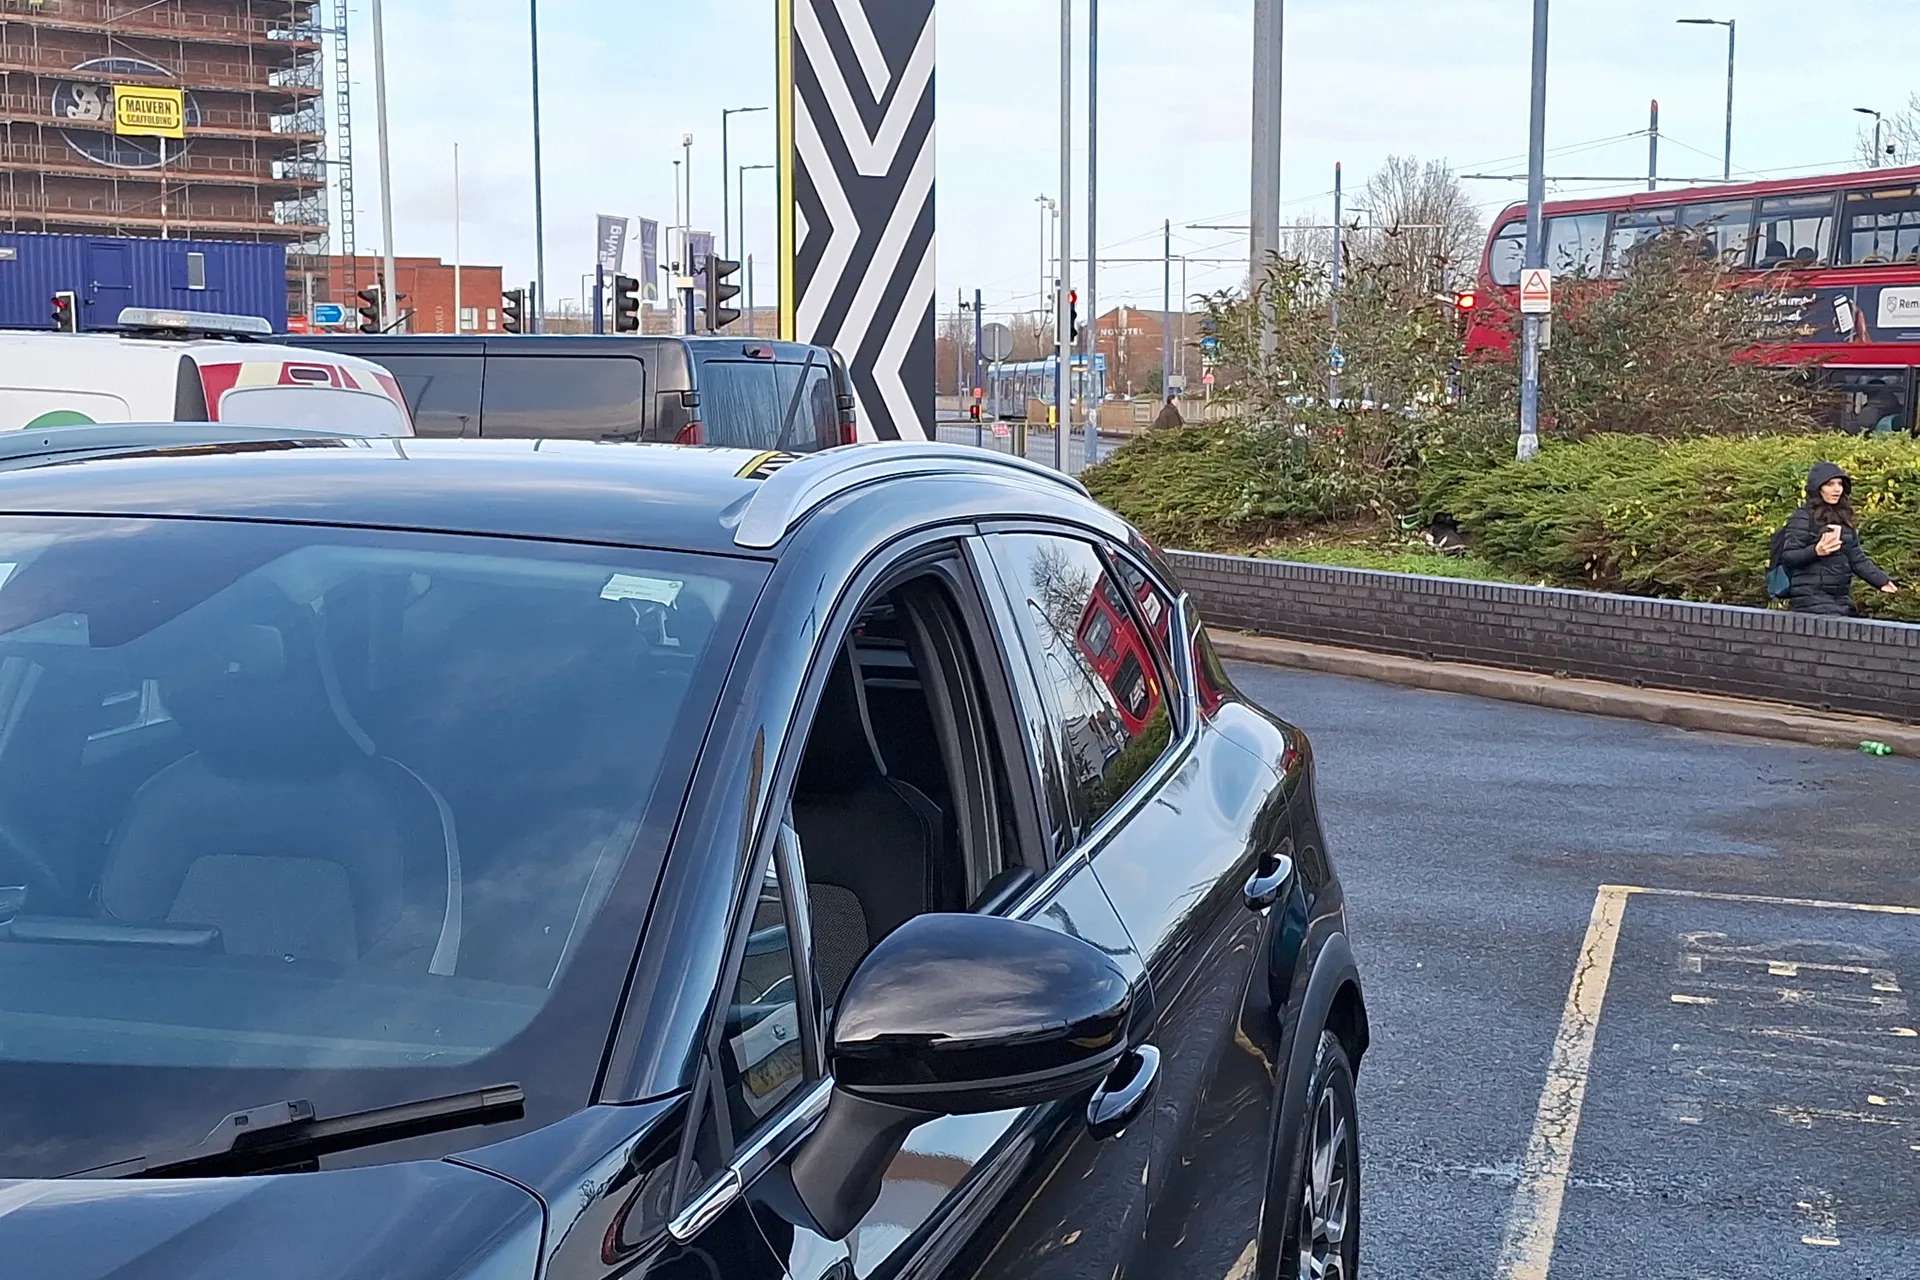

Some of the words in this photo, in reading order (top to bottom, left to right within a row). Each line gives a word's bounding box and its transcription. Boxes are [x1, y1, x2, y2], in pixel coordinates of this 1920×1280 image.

[126, 99, 171, 115] MALVERN
[127, 114, 172, 125] SCAFFOLDING
[1899, 299, 1919, 309] Rem
[1100, 328, 1144, 336] NOVOTEL
